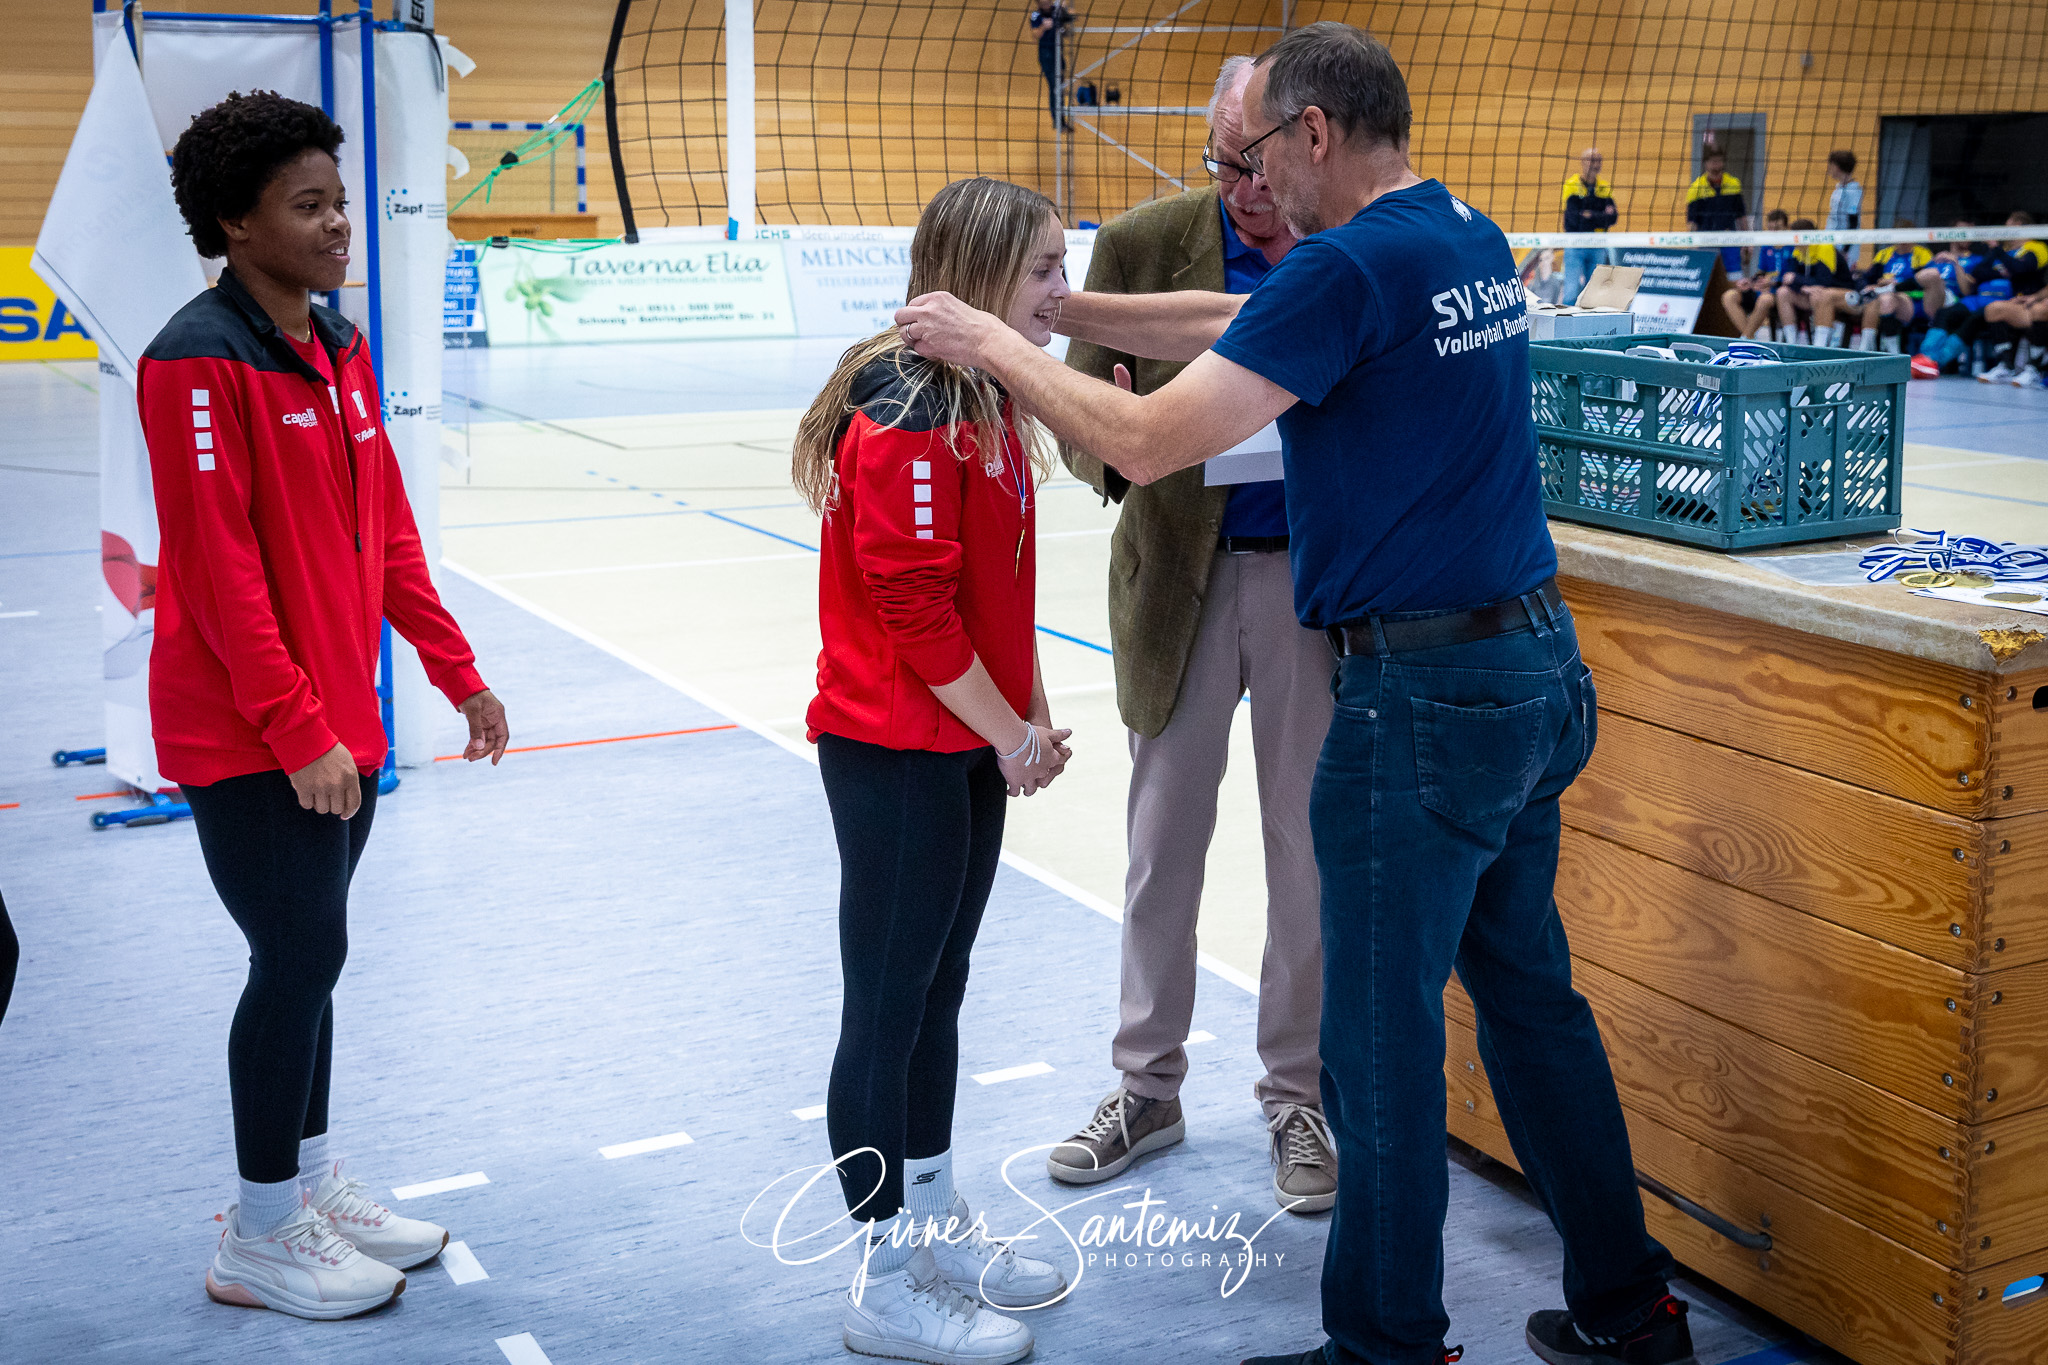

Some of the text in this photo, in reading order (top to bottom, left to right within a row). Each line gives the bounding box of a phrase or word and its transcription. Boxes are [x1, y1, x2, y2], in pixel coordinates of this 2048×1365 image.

[394, 203, 423, 216] Zapf
[1659, 236, 1693, 245] FUCHS
[1802, 234, 1835, 243] FUCHS
[1936, 231, 1968, 240] FUCHS
[565, 250, 771, 277] Taverna Elia
[1432, 285, 1474, 330] SV
[1433, 320, 1504, 357] Volleyball
[282, 408, 317, 426] capelli
[393, 405, 422, 417] Zapf
